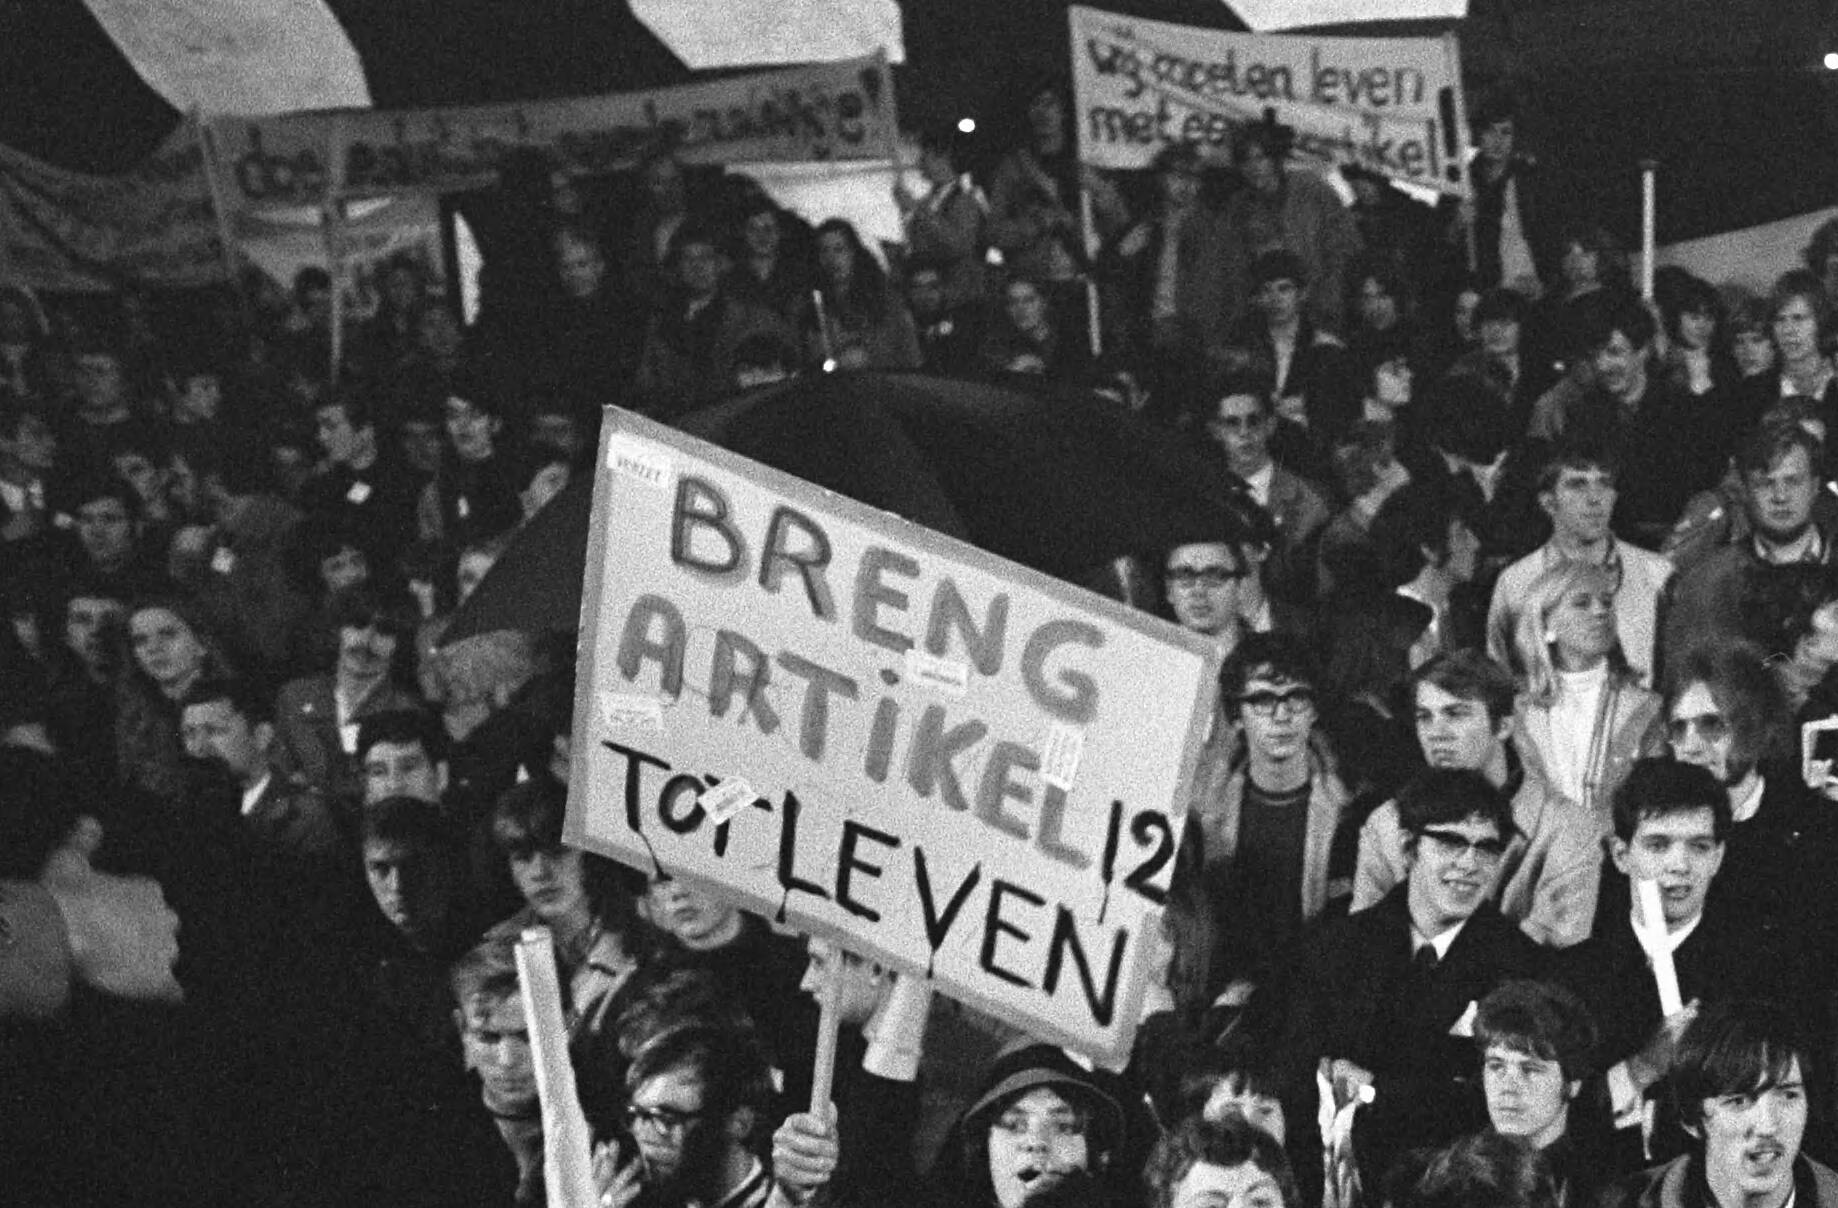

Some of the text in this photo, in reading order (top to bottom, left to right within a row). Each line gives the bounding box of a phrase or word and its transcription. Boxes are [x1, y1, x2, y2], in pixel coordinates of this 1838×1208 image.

[1089, 99, 1170, 145] met
[1312, 46, 1425, 106] leven
[670, 475, 1106, 724] BRENG
[1099, 799, 1175, 907] 12
[777, 790, 1129, 1028] LEVEN
